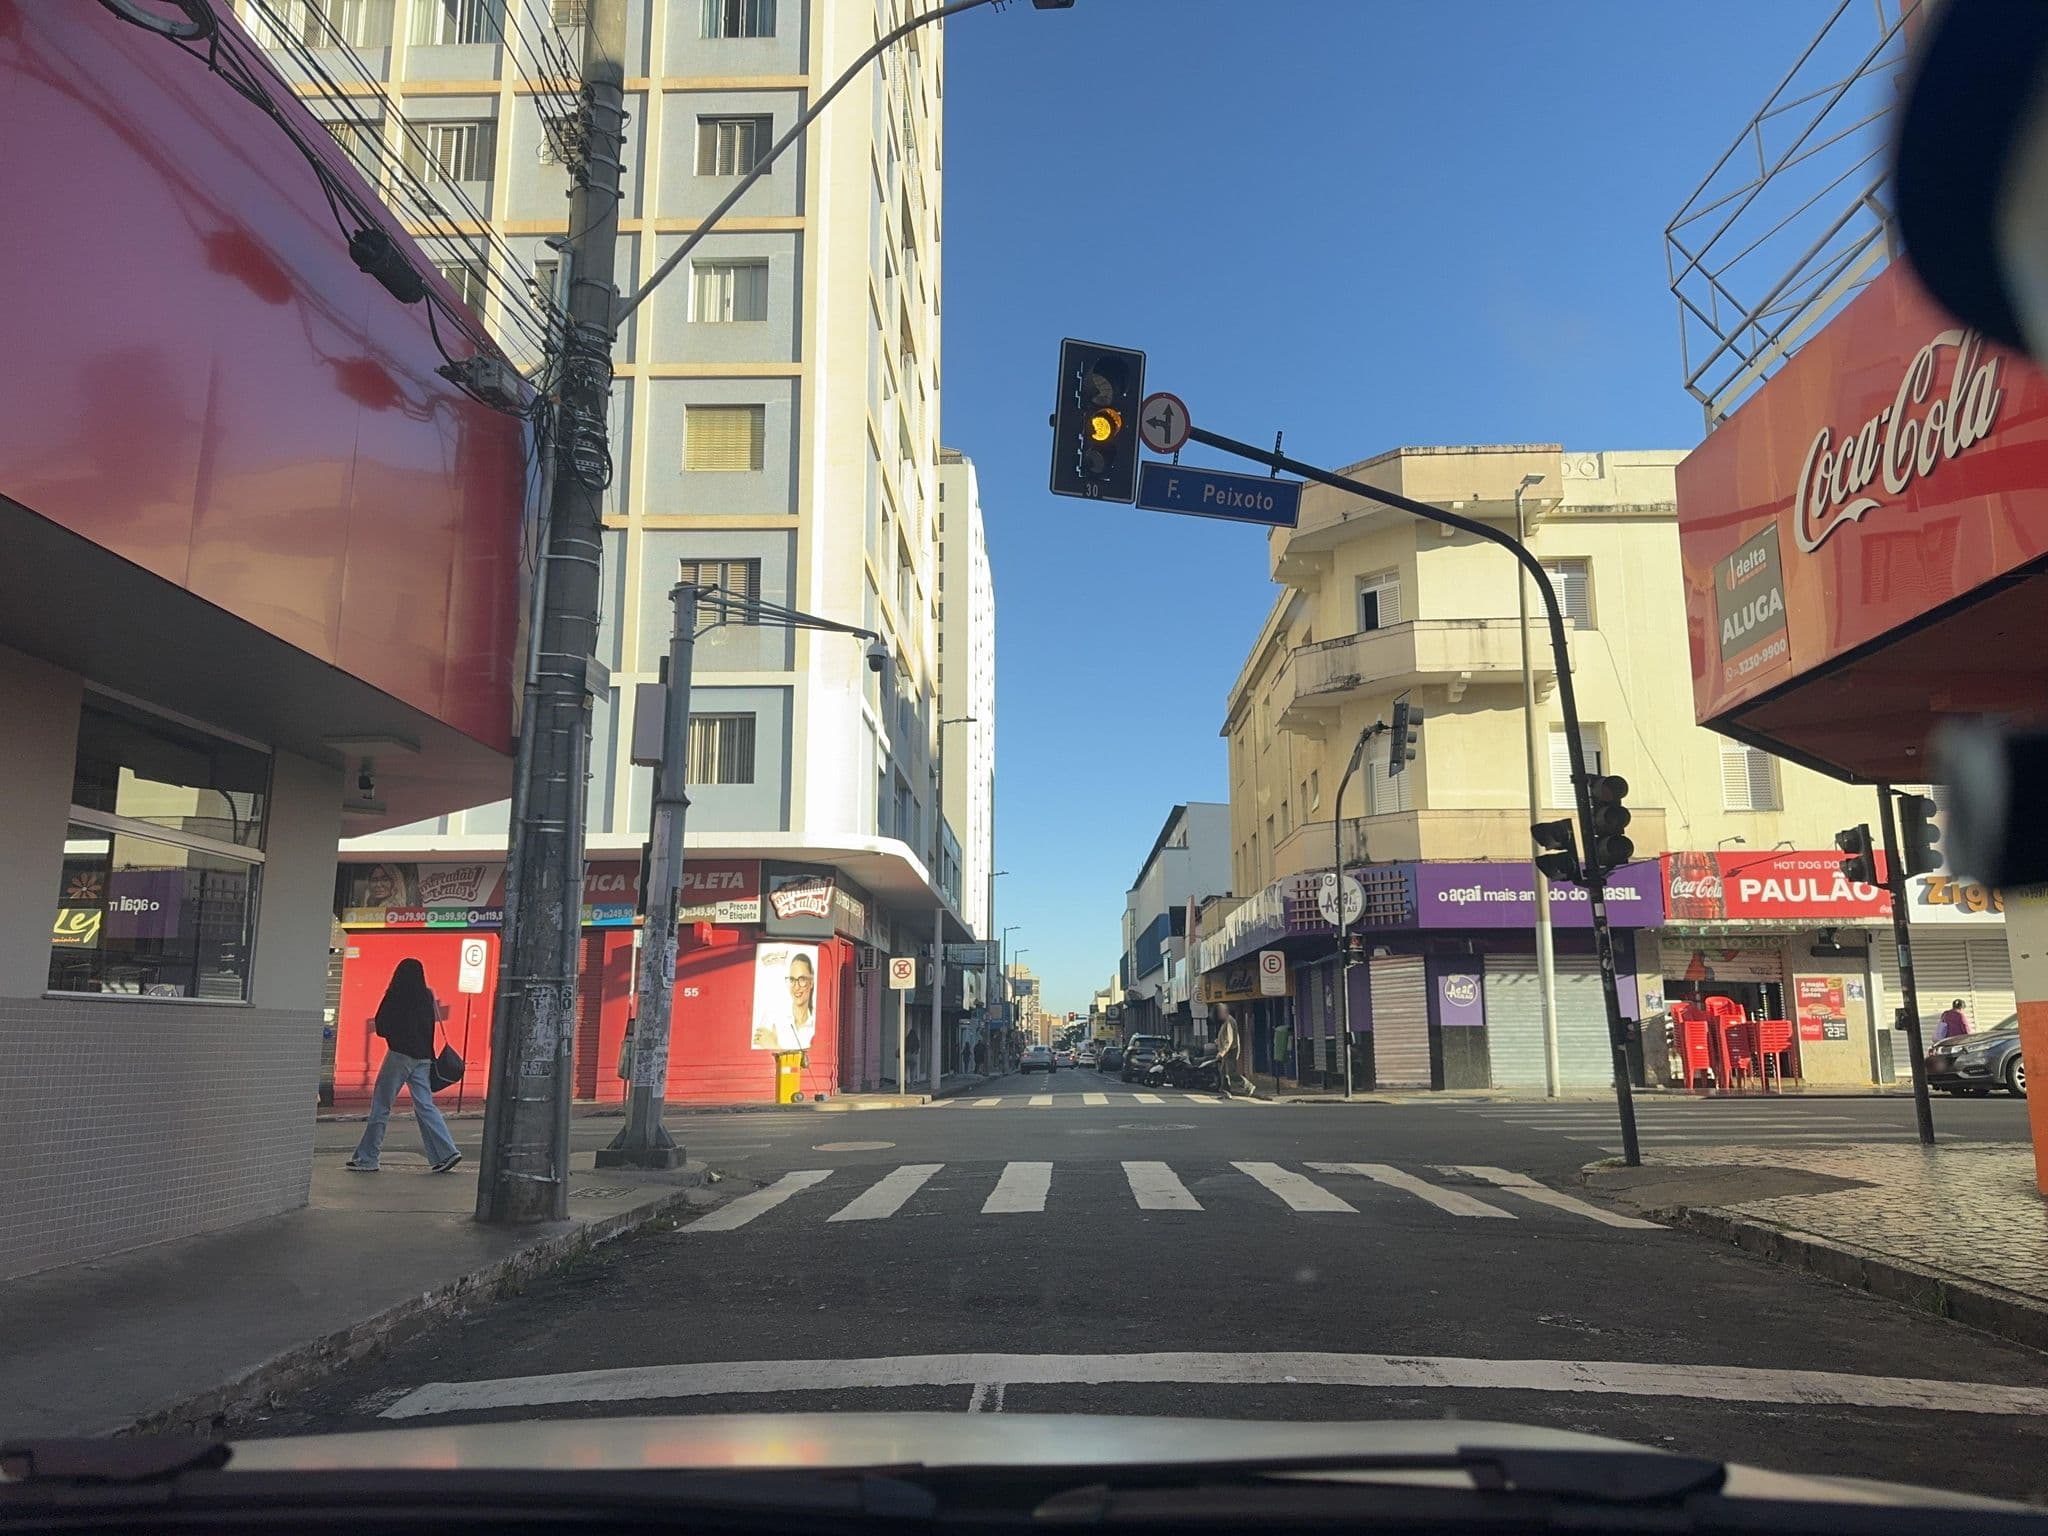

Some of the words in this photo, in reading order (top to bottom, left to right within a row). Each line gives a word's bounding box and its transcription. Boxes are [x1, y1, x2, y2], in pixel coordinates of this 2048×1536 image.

[1794, 329, 2000, 553] Coca-Cola
[1086, 483, 1099, 498] 30
[1167, 479, 1181, 499] F.
[1203, 483, 1274, 511] Peixoto
[1736, 547, 1766, 577] delta
[1722, 587, 1783, 645] ALUGA
[1773, 862, 1796, 870] HOT
[1798, 861, 1821, 870] DOG
[1824, 860, 1840, 869] DO
[583, 872, 626, 892] TICA
[633, 871, 745, 892] CPLETA
[1671, 876, 1723, 899] Coca-Cola
[1739, 873, 1879, 903] PAULÃO
[1438, 891, 1448, 902] o
[1484, 888, 1517, 901] mais
[1519, 888, 1567, 901] ado
[1569, 887, 1588, 901] do
[718, 908, 729, 916] 10
[729, 902, 747, 911] Preço
[479, 911, 503, 921] R$119,9
[729, 911, 757, 920] Etiqueta
[1268, 958, 1276, 970] E
[684, 987, 699, 997] 55
[1828, 1027, 1841, 1037] 23
